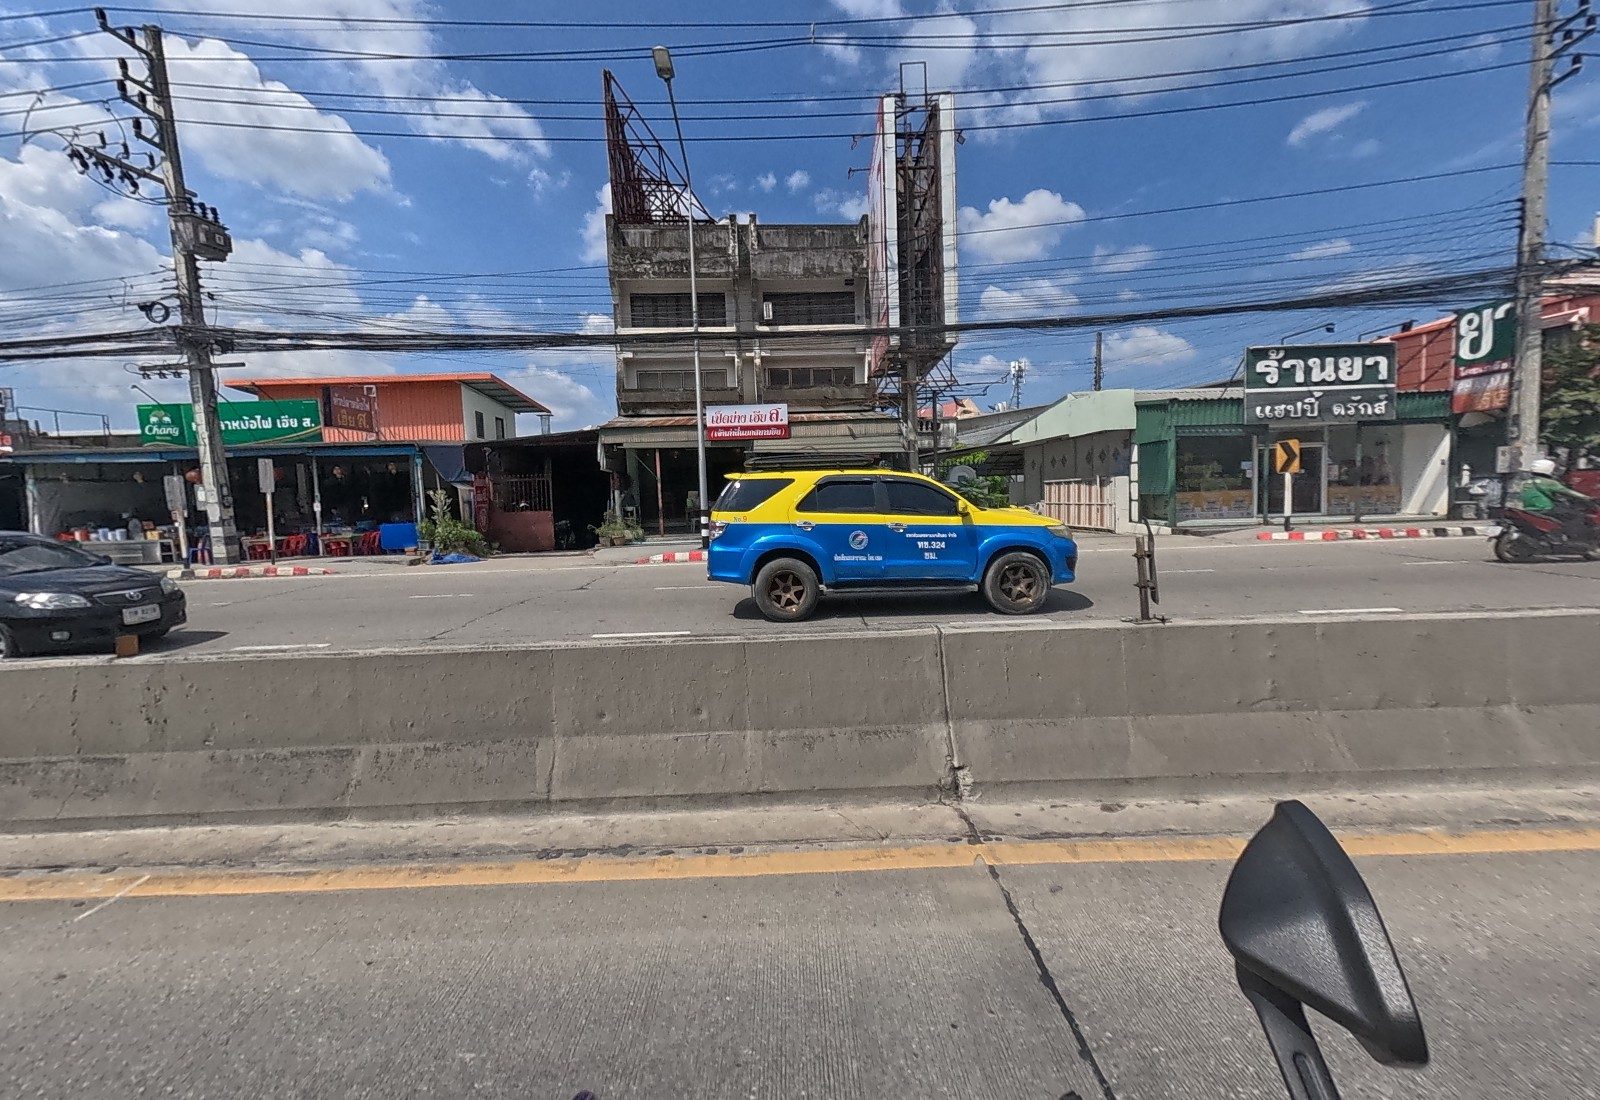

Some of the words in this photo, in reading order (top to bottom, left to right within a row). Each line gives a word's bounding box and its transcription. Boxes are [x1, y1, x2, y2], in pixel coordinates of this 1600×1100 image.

[1255, 349, 1389, 385] ร้านยา
[1255, 391, 1322, 419] แฮปปี้
[1332, 394, 1389, 416] ดรักส์
[144, 424, 180, 437] Chang
[302, 417, 315, 428] ส.
